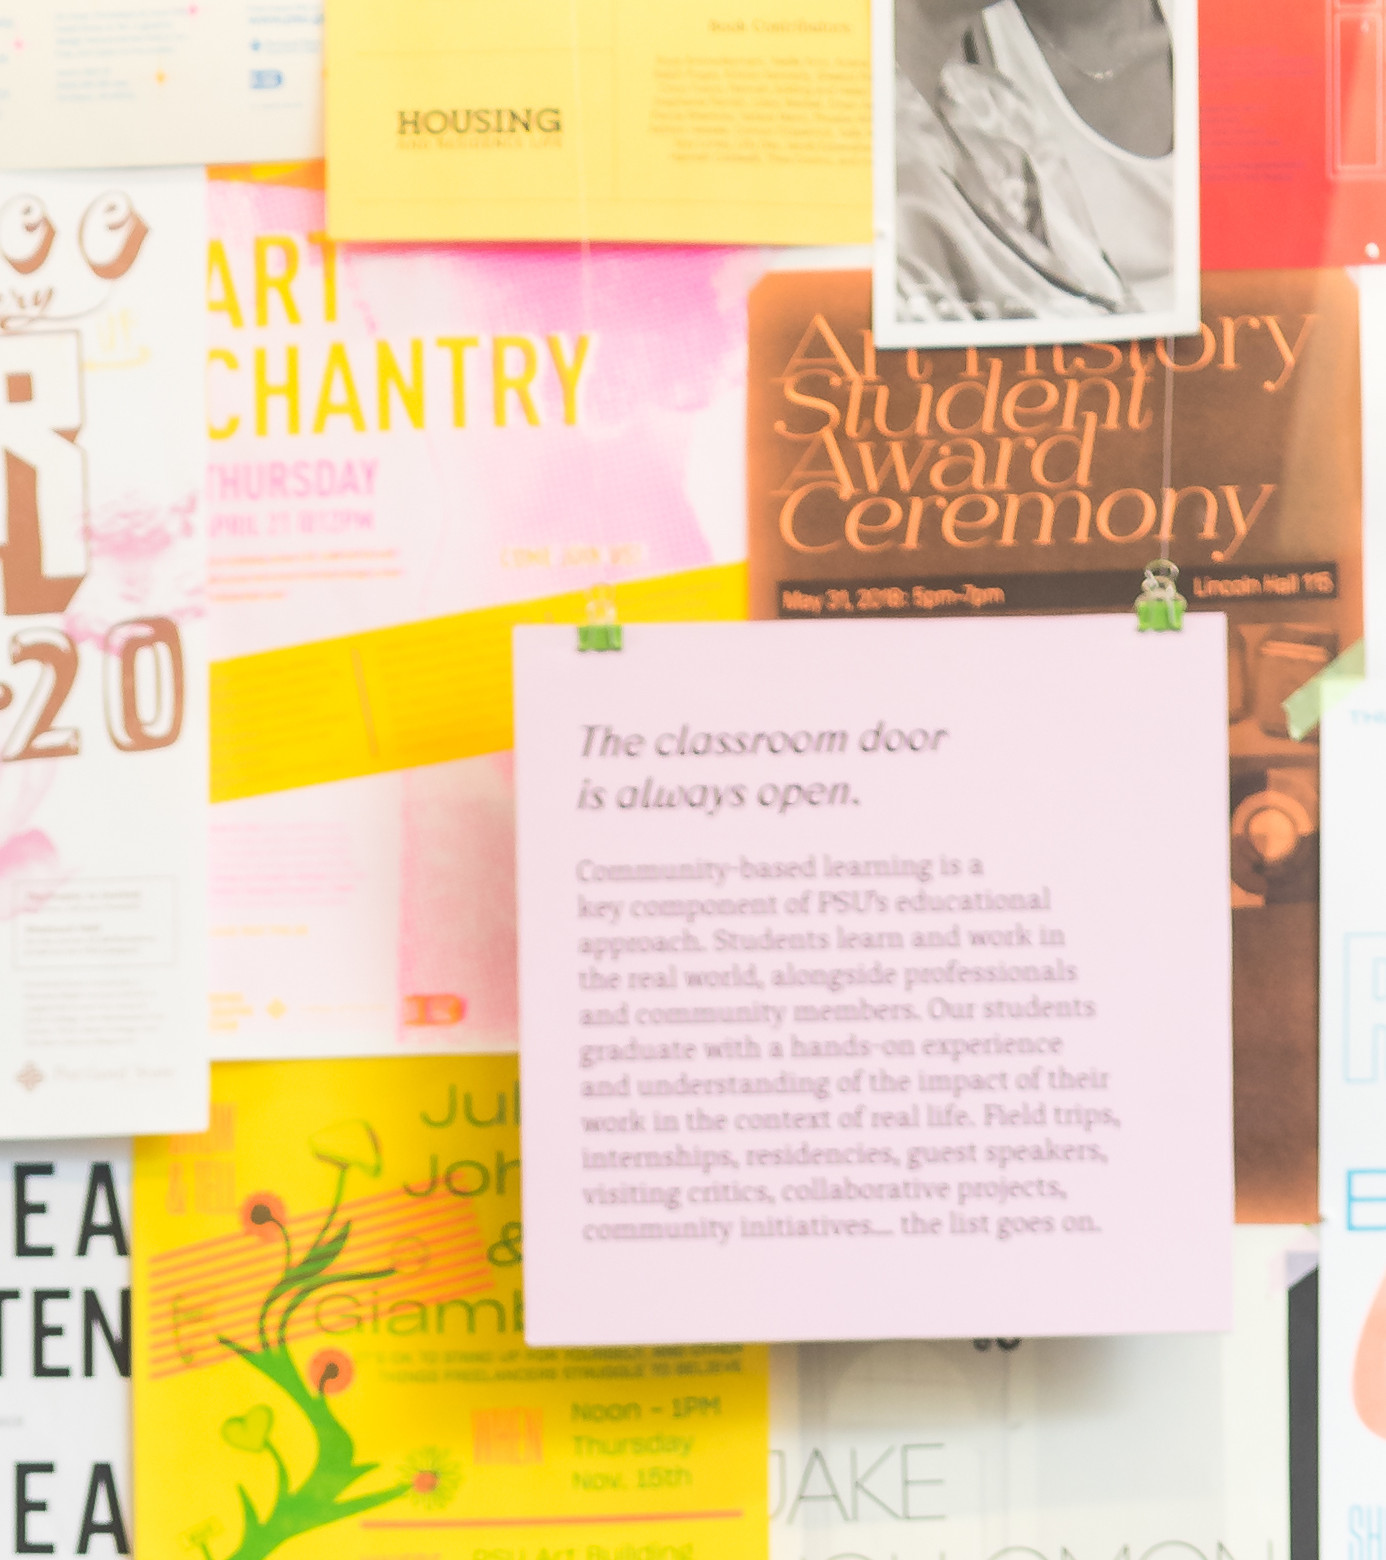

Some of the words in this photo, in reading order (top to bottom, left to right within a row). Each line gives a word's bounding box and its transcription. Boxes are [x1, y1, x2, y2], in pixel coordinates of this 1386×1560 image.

[397, 108, 562, 137] HOUSING
[212, 232, 342, 329] ART
[210, 332, 594, 439] CHANTRY
[776, 358, 1154, 442] Student
[776, 413, 1100, 502] Award
[779, 480, 1277, 560] Ceremony
[579, 724, 640, 758] The
[654, 724, 850, 758] classroom
[860, 721, 949, 755] door
[577, 779, 605, 810] is
[617, 778, 746, 816] always
[759, 779, 861, 814] open.
[768, 1440, 947, 1527] JAKE
